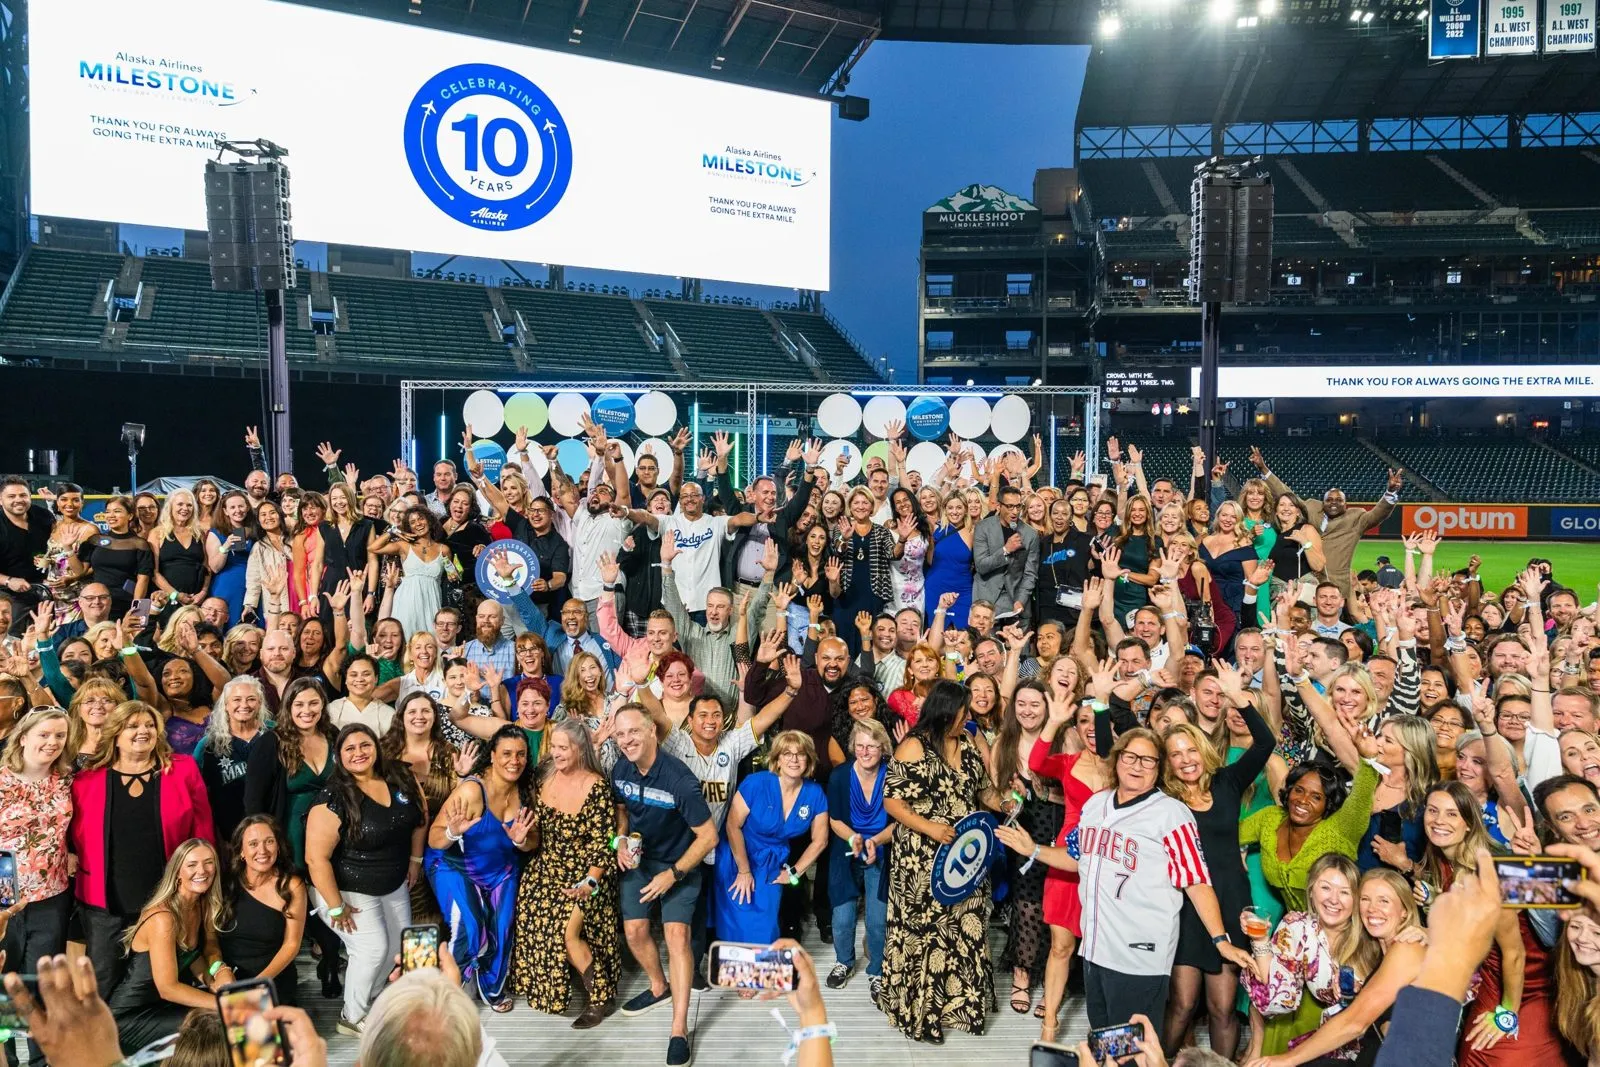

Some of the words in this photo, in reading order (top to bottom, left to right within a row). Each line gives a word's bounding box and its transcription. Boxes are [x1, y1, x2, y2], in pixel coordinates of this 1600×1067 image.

[1501, 5, 1525, 19] 1995
[1559, 3, 1582, 16] 1997
[1445, 22, 1464, 30] 2000
[1455, 14, 1471, 22] CARD
[1552, 20, 1566, 31] A.L.
[1567, 18, 1590, 30] WEST
[1445, 30, 1464, 38] 2022
[1494, 22, 1508, 33] A.L.
[1509, 21, 1531, 33] WEST
[1489, 35, 1535, 48] CHAMPIONS
[1547, 32, 1594, 45] CHAMPIONS
[115, 51, 155, 66] Alaska
[158, 57, 203, 73] Airlines
[79, 59, 235, 100] MILESTONE
[440, 77, 541, 116] CELEBRATING
[90, 114, 130, 128] THANK
[132, 120, 156, 131] YOU
[159, 124, 181, 135] FOR
[183, 127, 227, 140] ALWAYS
[92, 127, 132, 140] GOING
[135, 132, 156, 143] THE
[159, 135, 193, 148] EXTRA
[451, 113, 529, 177] 10
[726, 145, 751, 156] Alaska
[753, 150, 782, 161] Airlines
[702, 153, 802, 182] MILESTONE
[470, 176, 513, 192] YEARS
[708, 196, 735, 206] THANK
[736, 199, 751, 208] YOU
[752, 202, 767, 210] FOR
[768, 204, 797, 214] ALWAYS
[470, 207, 509, 221] Alaska
[710, 206, 736, 216] GOING
[737, 209, 751, 218] THE
[752, 211, 775, 220] EXTRA
[776, 215, 795, 224] MILE.
[939, 212, 1026, 222] MUCKLESHOOT
[472, 219, 505, 227] AIRLINES
[1326, 377, 1364, 386] THANK
[1366, 377, 1389, 386] YOU
[1391, 377, 1413, 386] FOR
[1415, 377, 1459, 386] ALWAYS
[1462, 376, 1500, 386] GOING
[1502, 376, 1523, 385] THE
[1526, 376, 1561, 385] EXTRA
[1564, 376, 1594, 385] MILE.
[597, 408, 630, 418] MILESTONE
[1413, 506, 1516, 535] Optum
[1560, 517, 1600, 530] GLO
[673, 527, 713, 548] Dodgers
[949, 837, 981, 877] 10
[1079, 826, 1139, 873] DRES
[1115, 873, 1129, 900] 7
